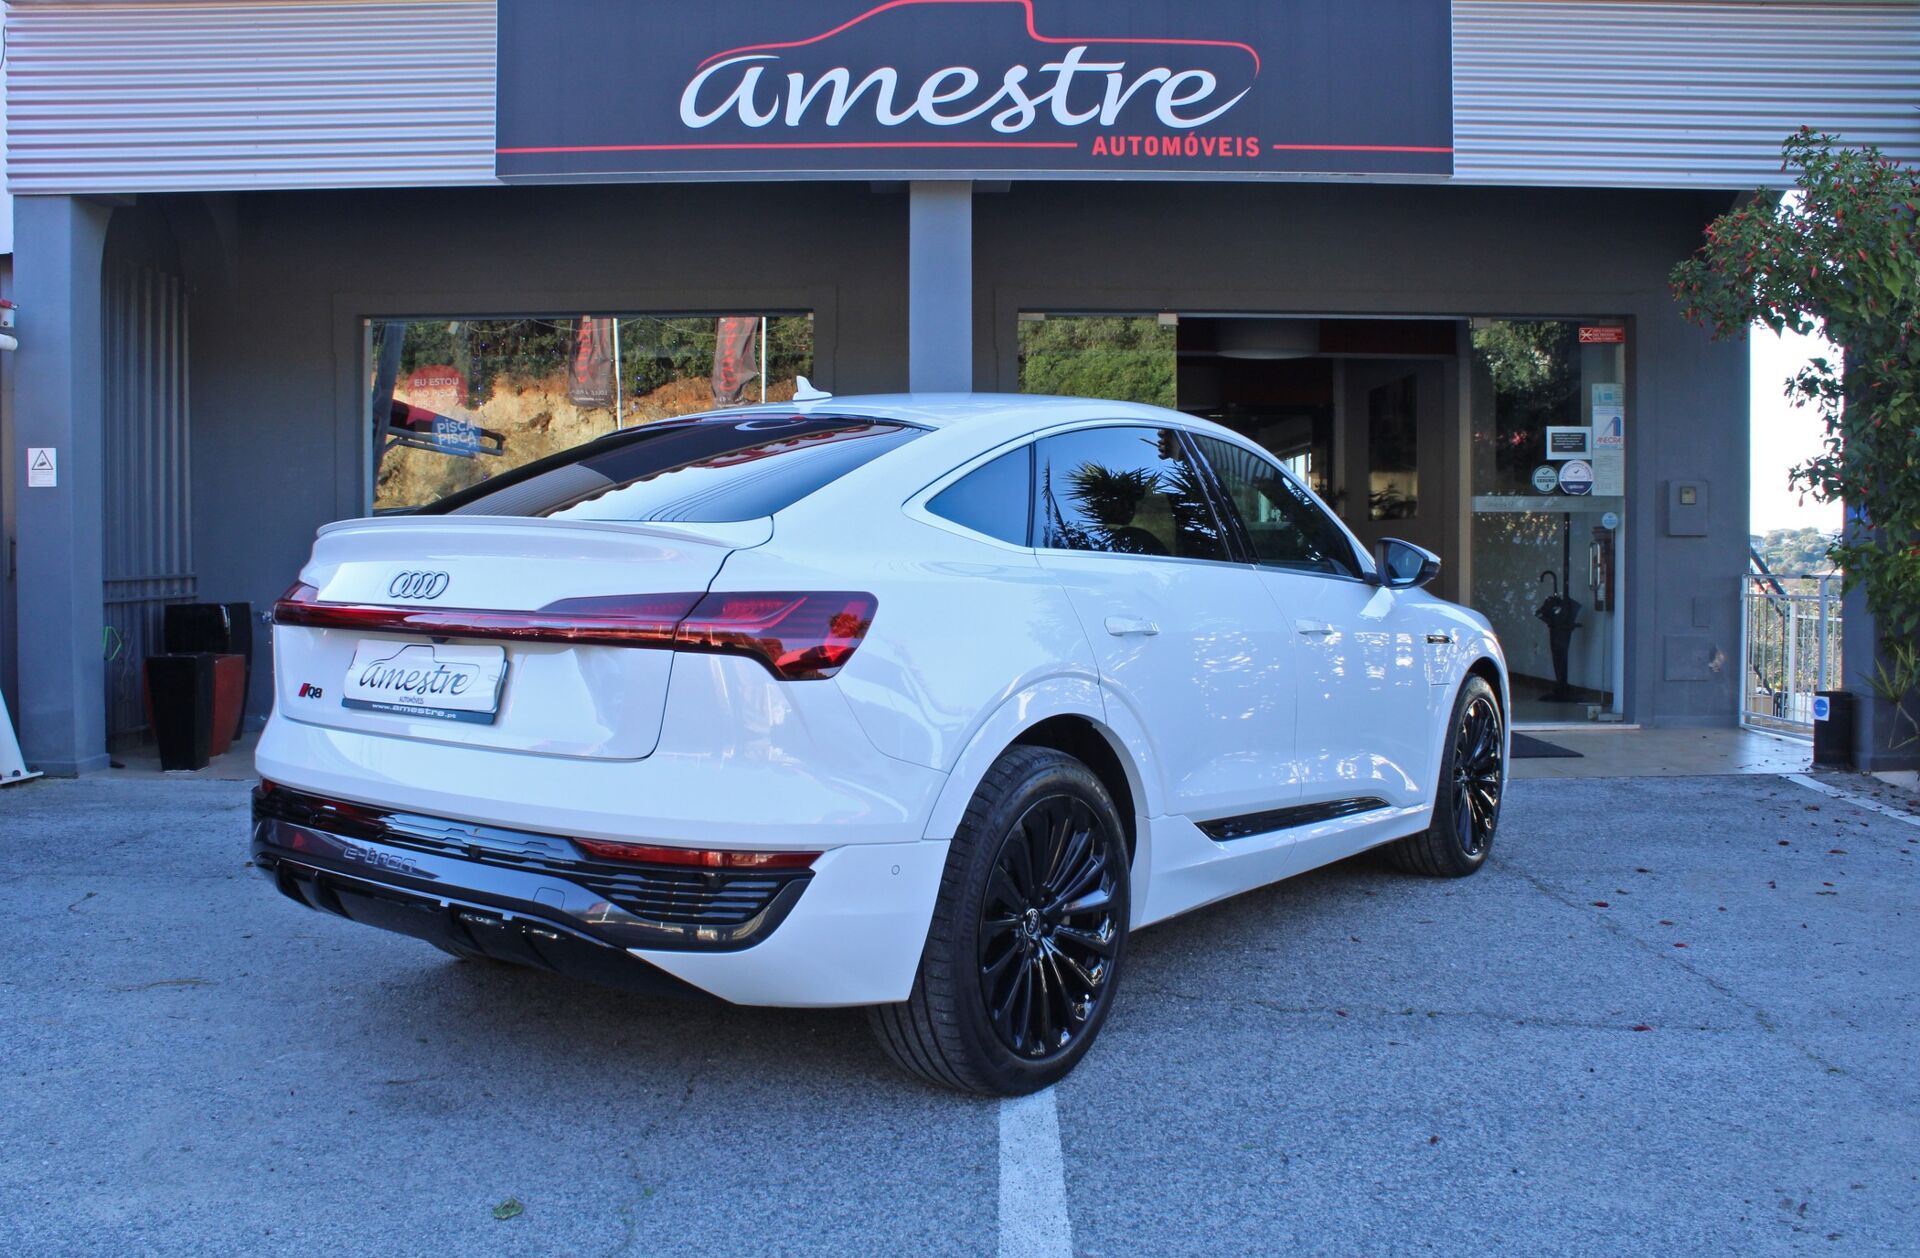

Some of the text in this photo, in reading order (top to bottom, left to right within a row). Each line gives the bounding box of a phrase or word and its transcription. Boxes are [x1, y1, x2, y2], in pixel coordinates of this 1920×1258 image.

[678, 46, 1252, 133] amestre
[1091, 131, 1261, 157] AUTOMÓVEIS
[414, 377, 459, 387] EU ESTOU
[359, 662, 468, 695] amestre
[372, 703, 456, 719] www.amestre.pt
